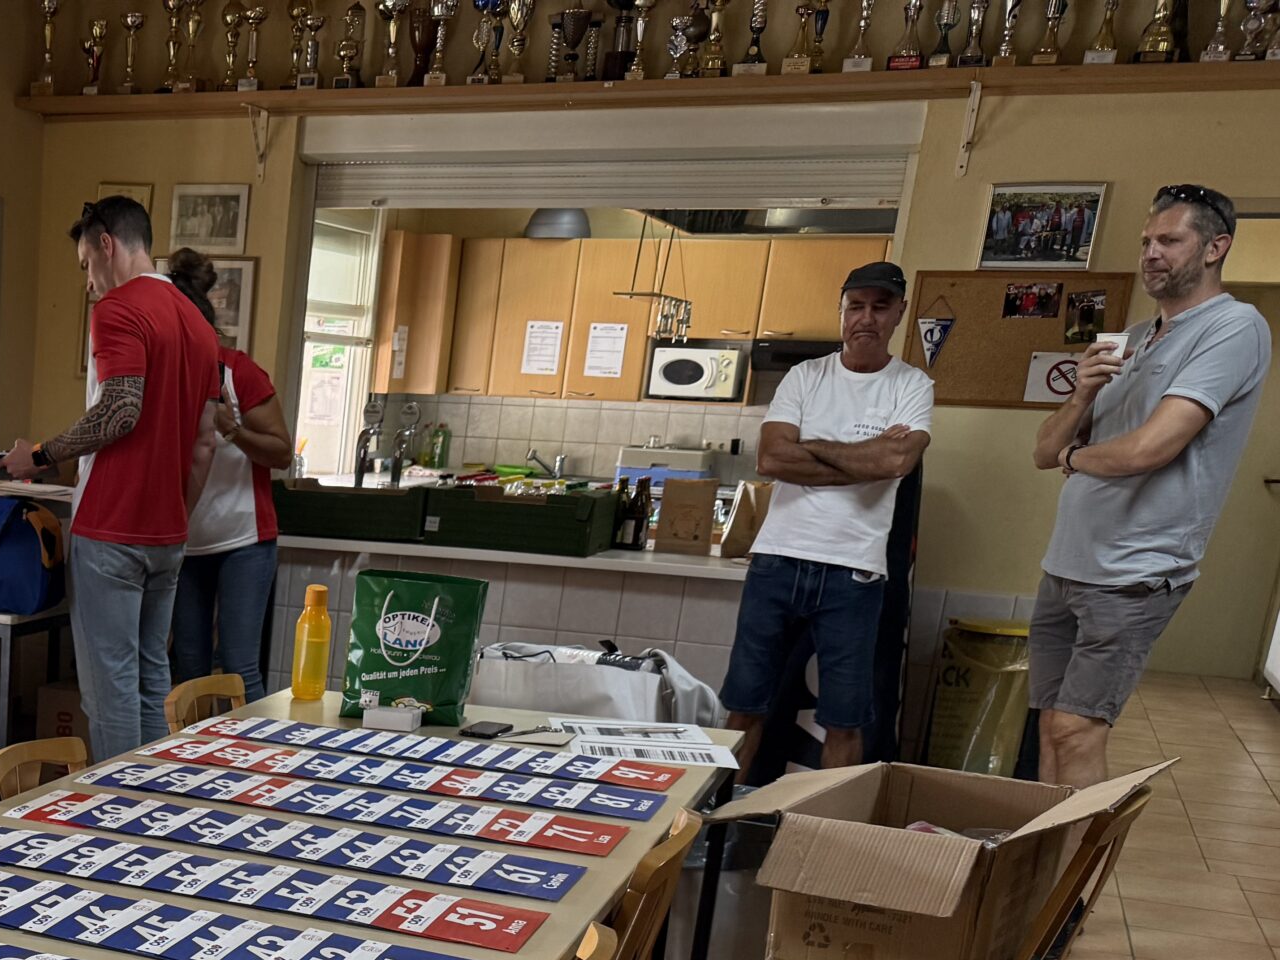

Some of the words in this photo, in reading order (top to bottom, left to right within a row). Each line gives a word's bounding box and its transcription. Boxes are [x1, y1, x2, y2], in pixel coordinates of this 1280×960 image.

[361, 671, 386, 681] Qualität
[399, 667, 419, 679] jeden
[420, 665, 438, 674] Preis
[611, 766, 655, 780] 91
[589, 792, 635, 809] 81
[543, 824, 594, 842] 71
[492, 863, 548, 884] 61
[444, 906, 505, 931] 51
[502, 919, 527, 935] Anna
